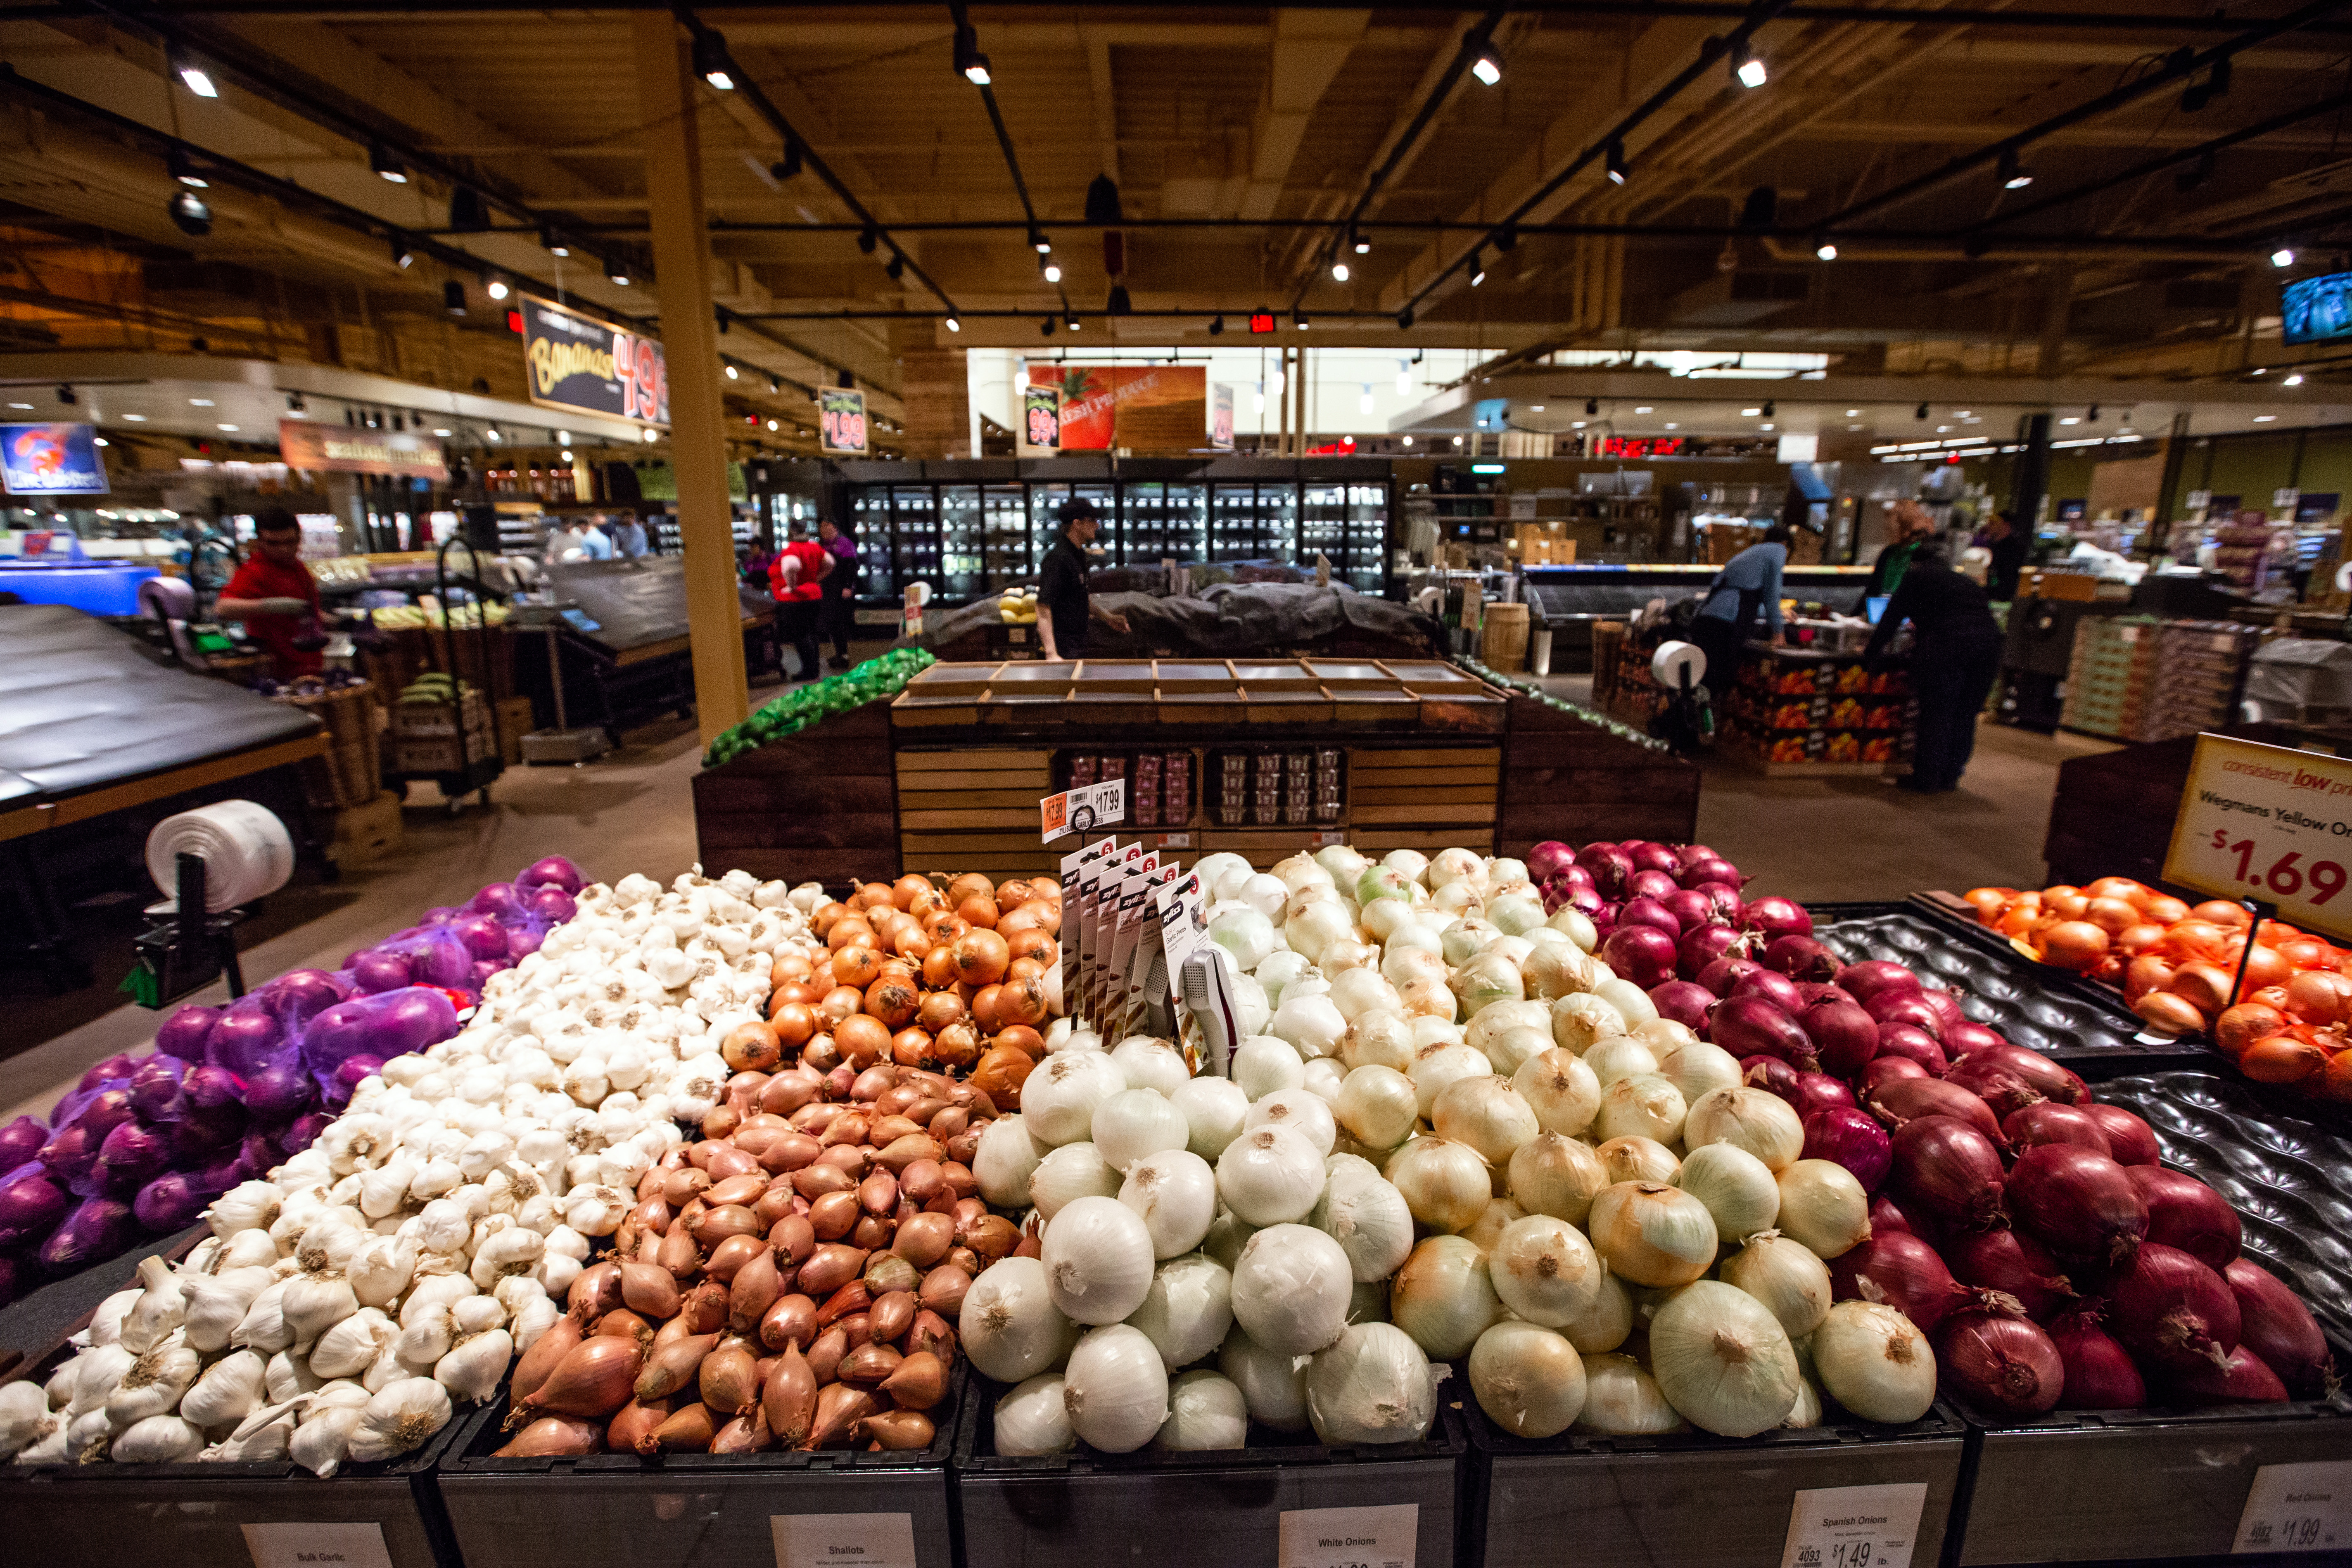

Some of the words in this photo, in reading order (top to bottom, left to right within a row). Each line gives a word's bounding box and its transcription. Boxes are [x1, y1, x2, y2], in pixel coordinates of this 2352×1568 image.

[529, 337, 614, 395] Bananas
[2222, 761, 2293, 783] consistent
[2293, 769, 2332, 790] low
[2329, 782, 2352, 796] pri
[1096, 789, 1119, 813] $17.99
[2200, 790, 2270, 817] Wegmans
[2275, 807, 2327, 830] Yellow
[1077, 820, 1091, 828] GARLIC
[1105, 846, 1110, 855] 5
[1147, 861, 1152, 872] 5
[2211, 829, 2347, 905] $1.69
[1167, 872, 1174, 882] 5
[1163, 905, 1181, 923] zyliss
[1166, 934, 1177, 944] Garlic
[1177, 926, 1187, 937] Press
[1823, 1516, 1856, 1528] Spanish
[1858, 1516, 1888, 1525] Onions
[1318, 1539, 1343, 1547] White
[1345, 1537, 1376, 1546] Onions
[829, 1545, 864, 1554] Shallots
[297, 1553, 317, 1561] Bulk
[319, 1552, 346, 1561] Garlic
[1798, 1550, 1820, 1562] 4093
